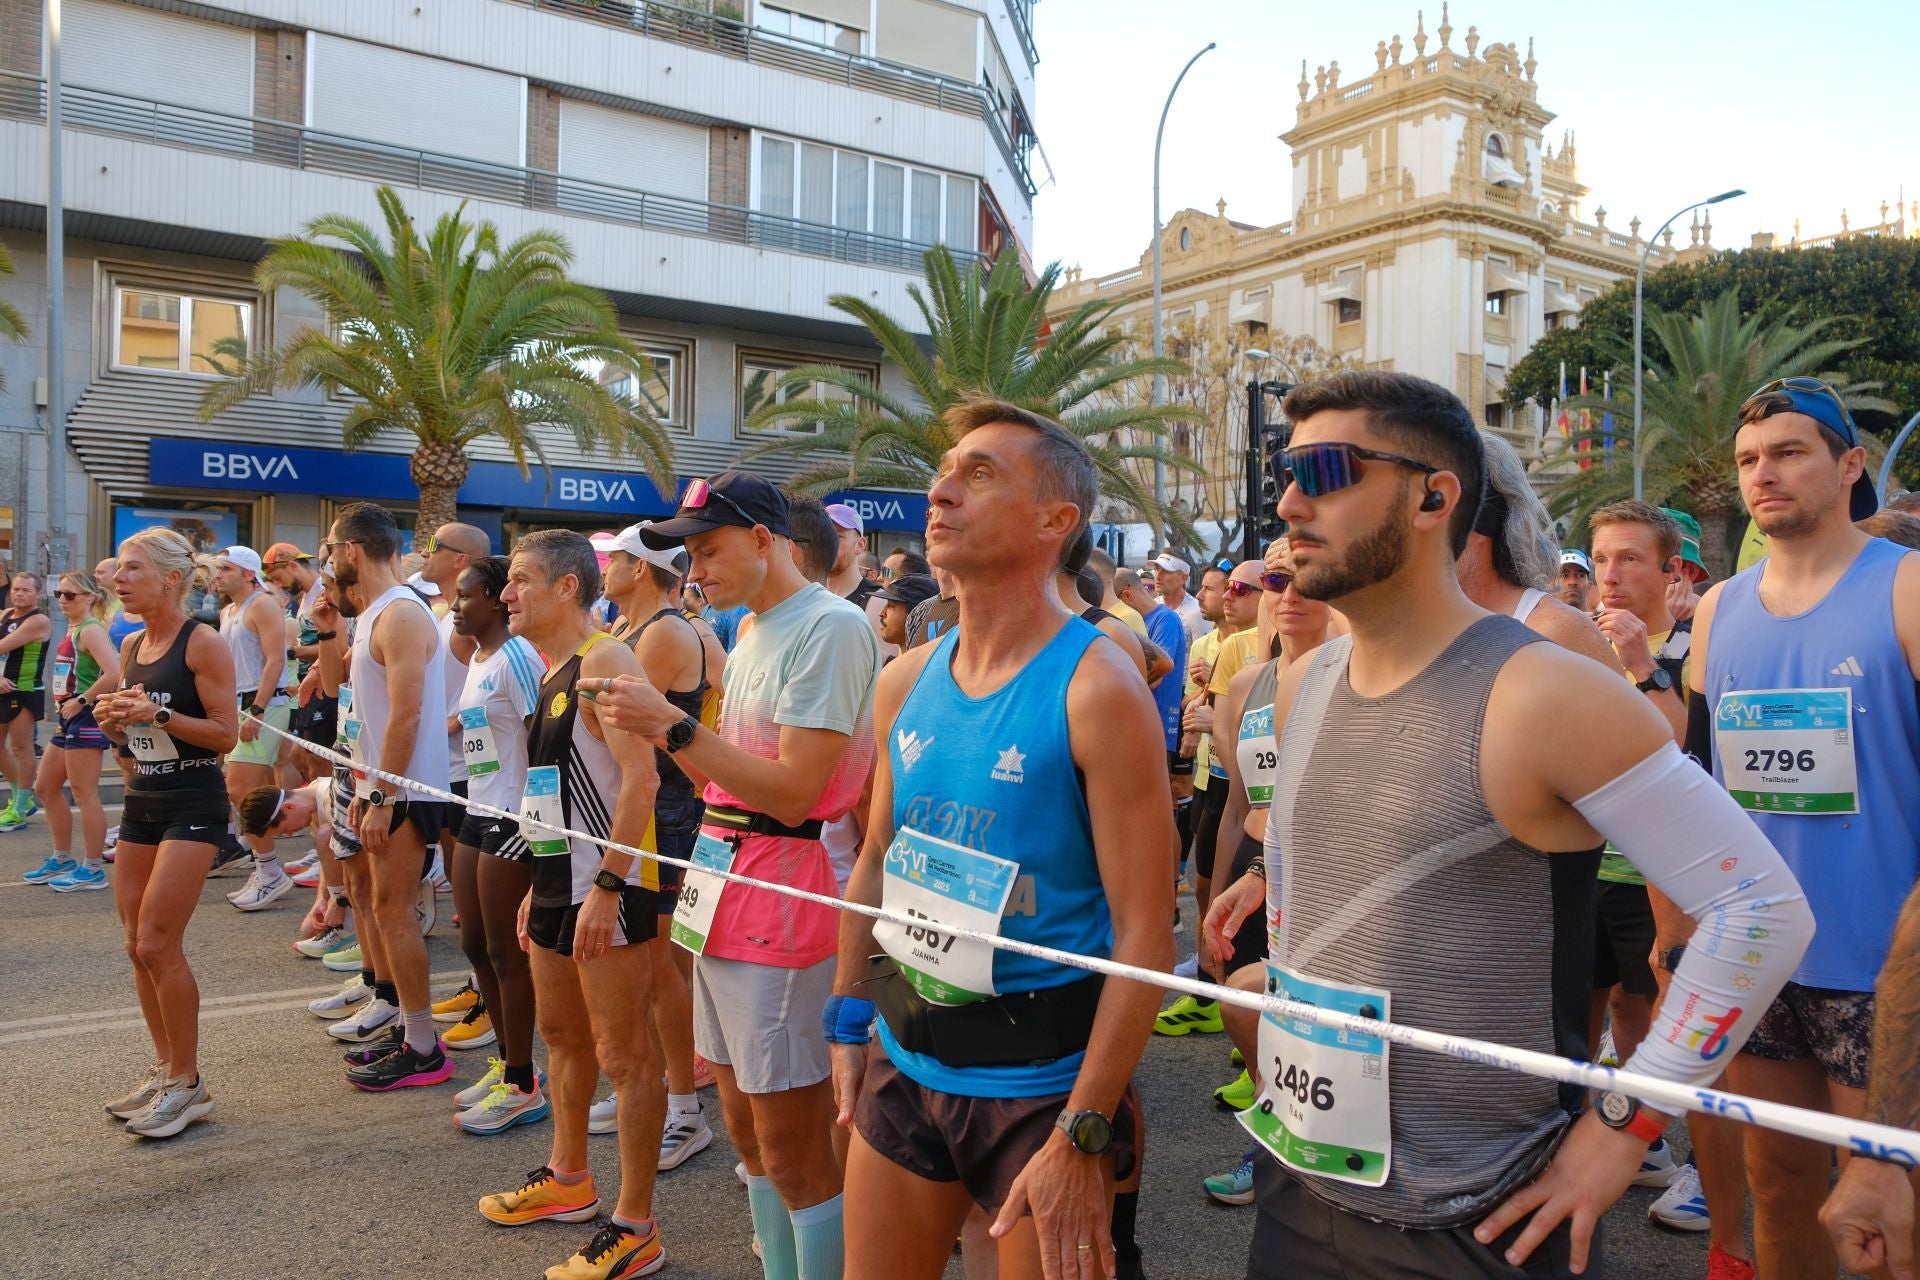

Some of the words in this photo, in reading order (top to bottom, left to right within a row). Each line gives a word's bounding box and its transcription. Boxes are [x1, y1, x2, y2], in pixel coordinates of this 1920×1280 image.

[203, 452, 299, 480] BBVA
[560, 477, 635, 502] BBVA
[137, 761, 176, 775] NIKE
[1744, 749, 1816, 772] 2796
[990, 769, 1024, 784] luanvi
[1761, 776, 1799, 784] Trailblazer
[933, 879, 950, 893] 2025
[911, 947, 940, 966] JUANMA
[1294, 1020, 1313, 1036] 2025
[1274, 1056, 1335, 1111] 2486
